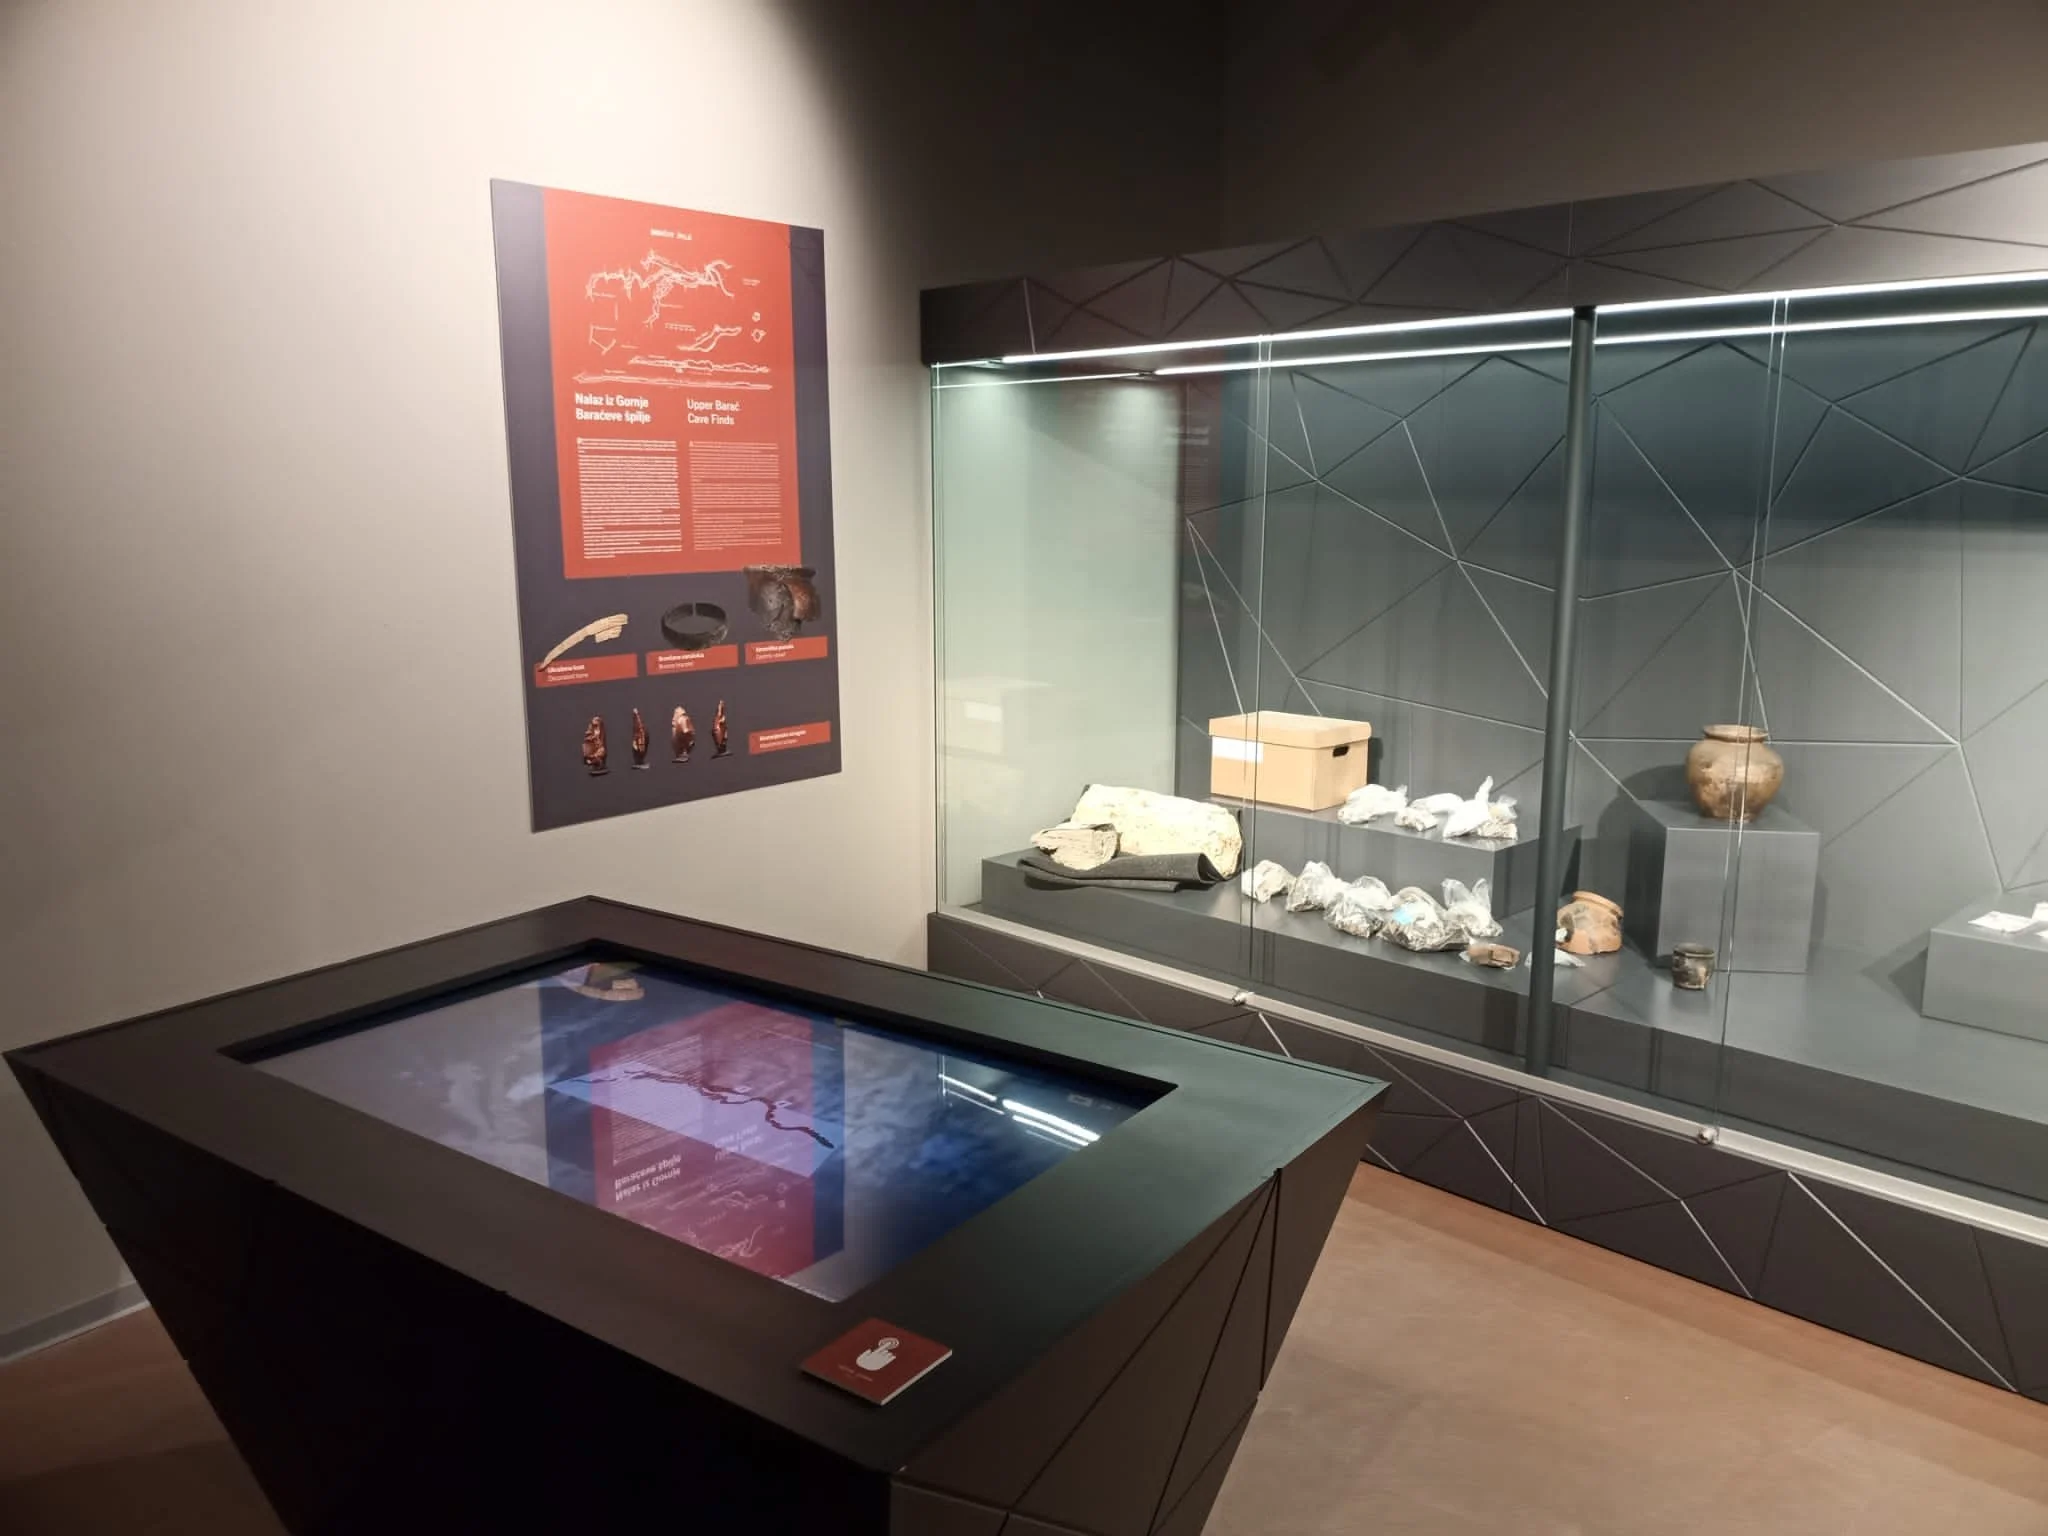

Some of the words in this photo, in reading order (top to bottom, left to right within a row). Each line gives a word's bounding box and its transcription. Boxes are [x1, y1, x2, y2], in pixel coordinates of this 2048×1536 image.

[575, 392, 603, 406] Nalaz
[605, 394, 614, 406] iz
[615, 394, 649, 409] Gornje
[687, 399, 713, 411] Upper
[687, 412, 710, 425] Cave
[711, 413, 735, 425] Finds
